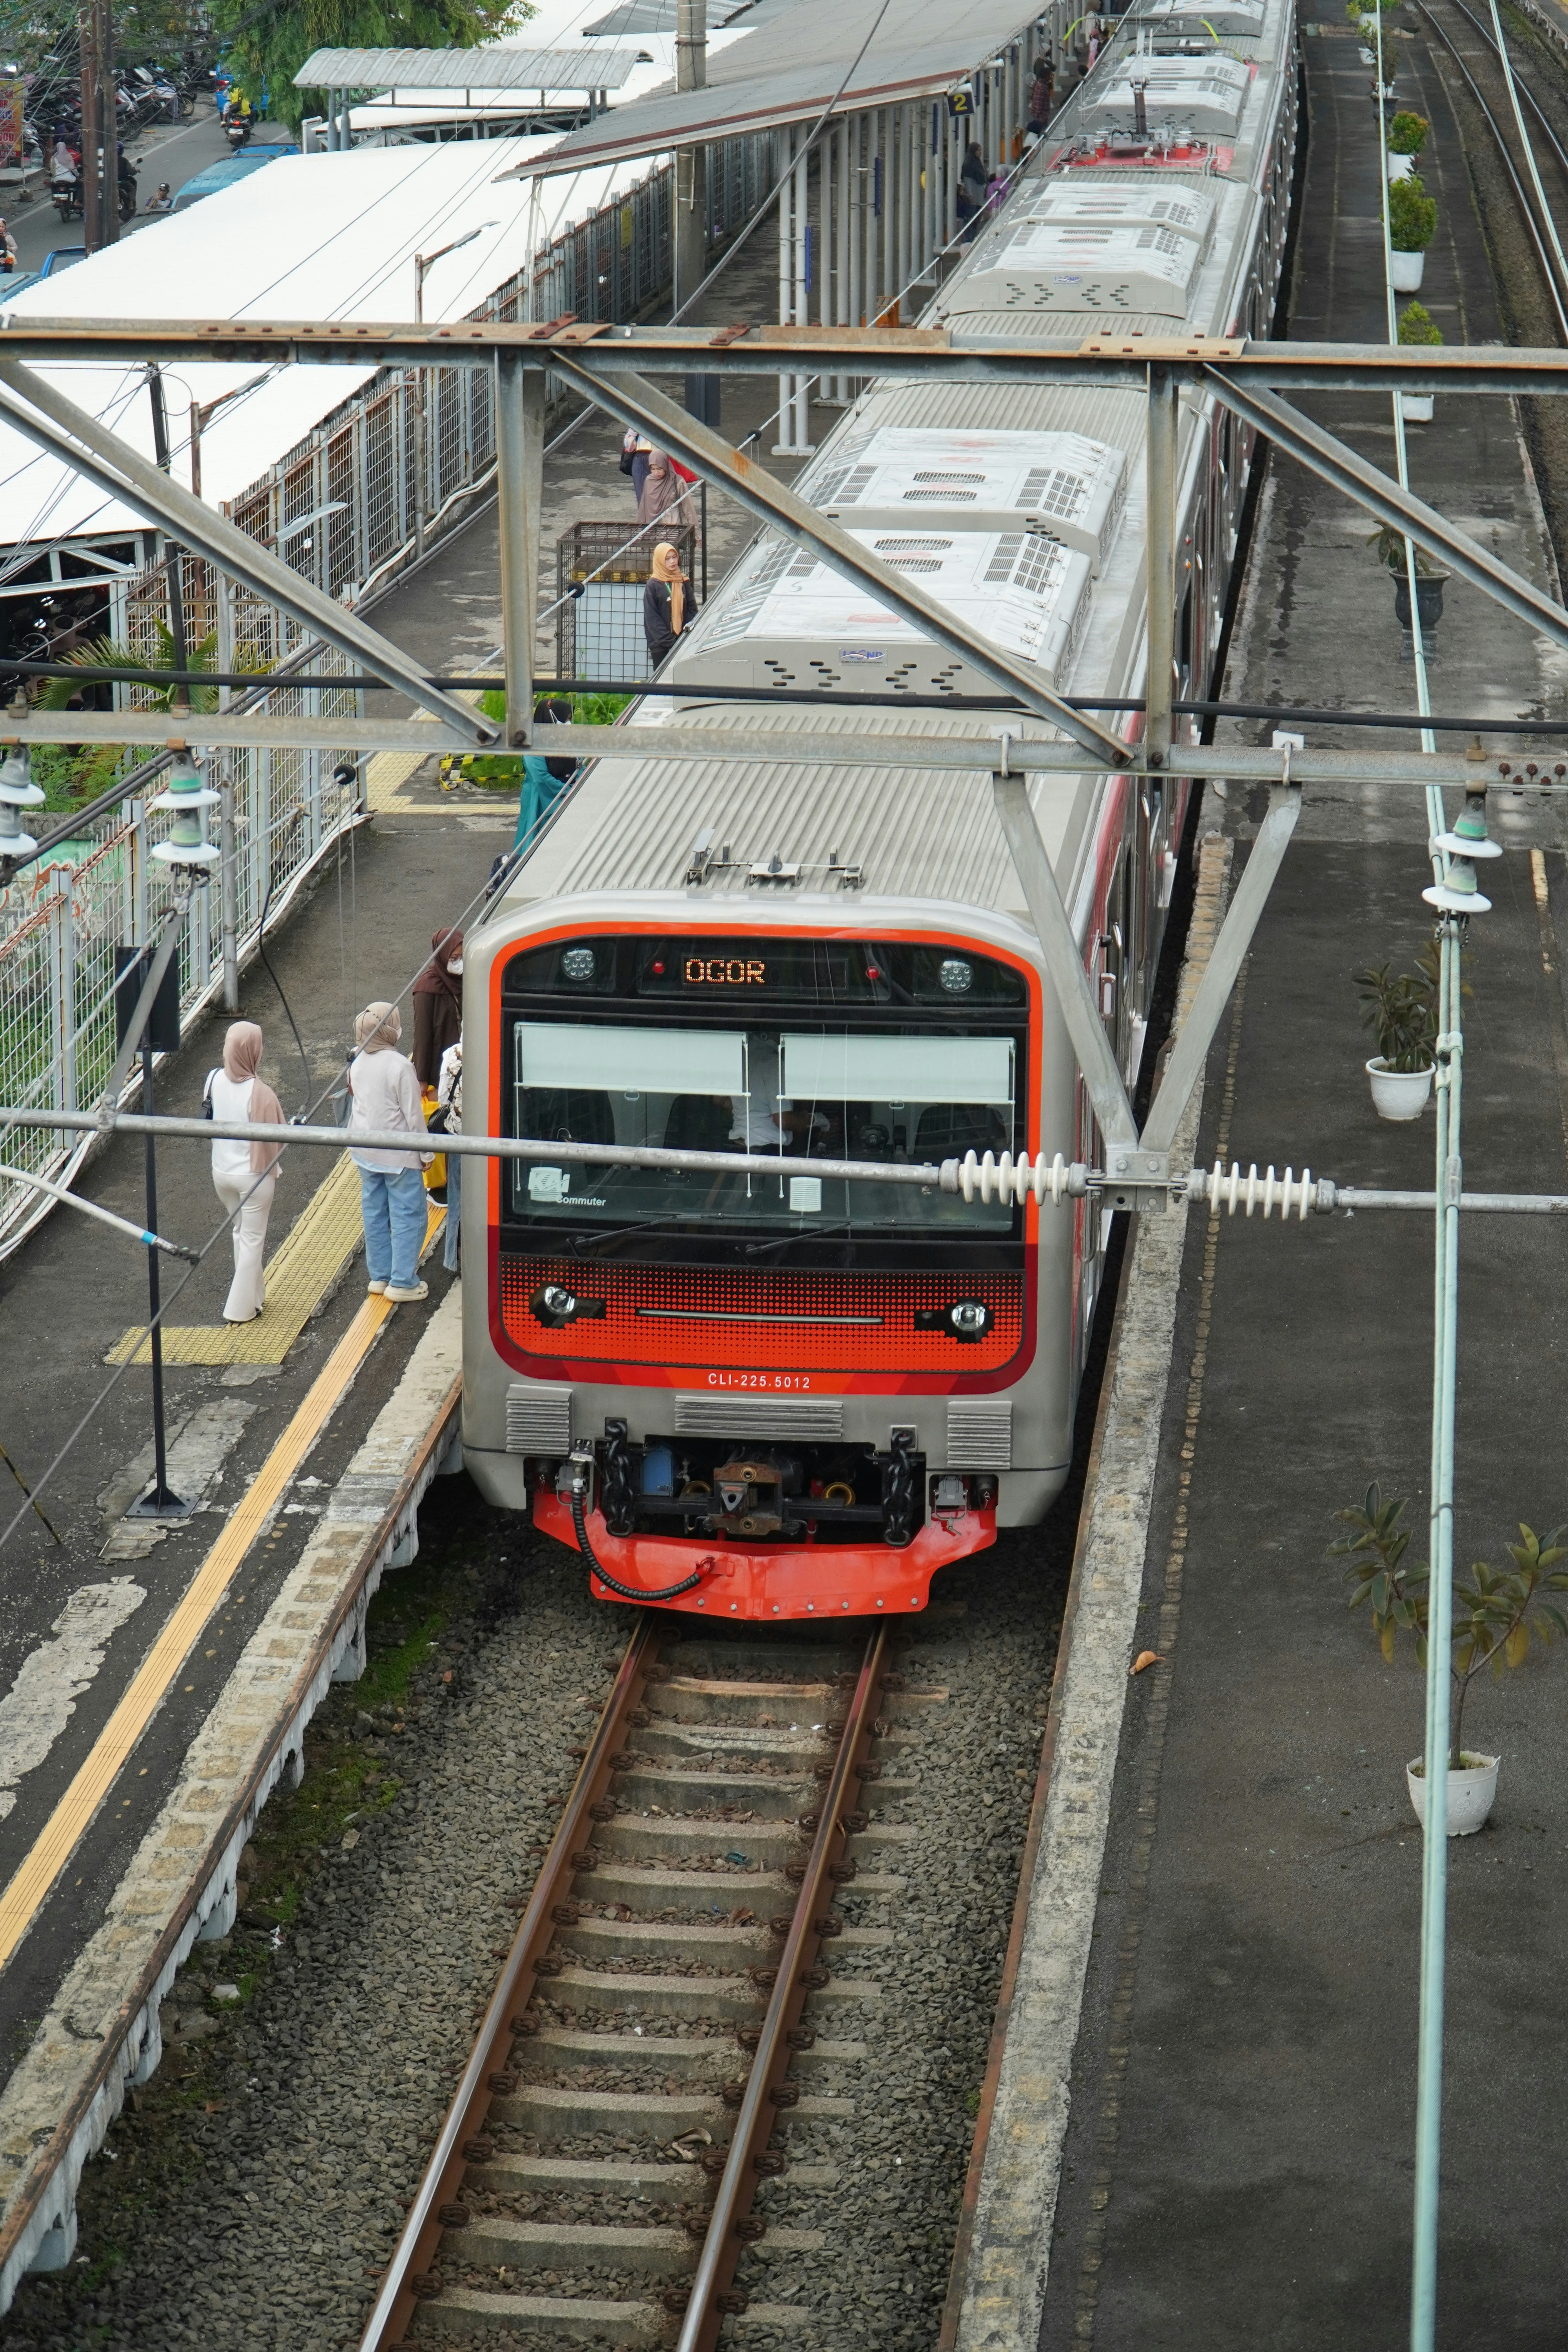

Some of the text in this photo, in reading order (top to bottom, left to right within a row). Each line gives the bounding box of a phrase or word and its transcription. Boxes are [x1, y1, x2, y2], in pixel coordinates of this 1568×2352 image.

[954, 94, 968, 111] 2
[686, 959, 765, 984] OGOR
[557, 1194, 606, 1206] Commuter
[708, 1373, 810, 1388] CLI-225.5012
